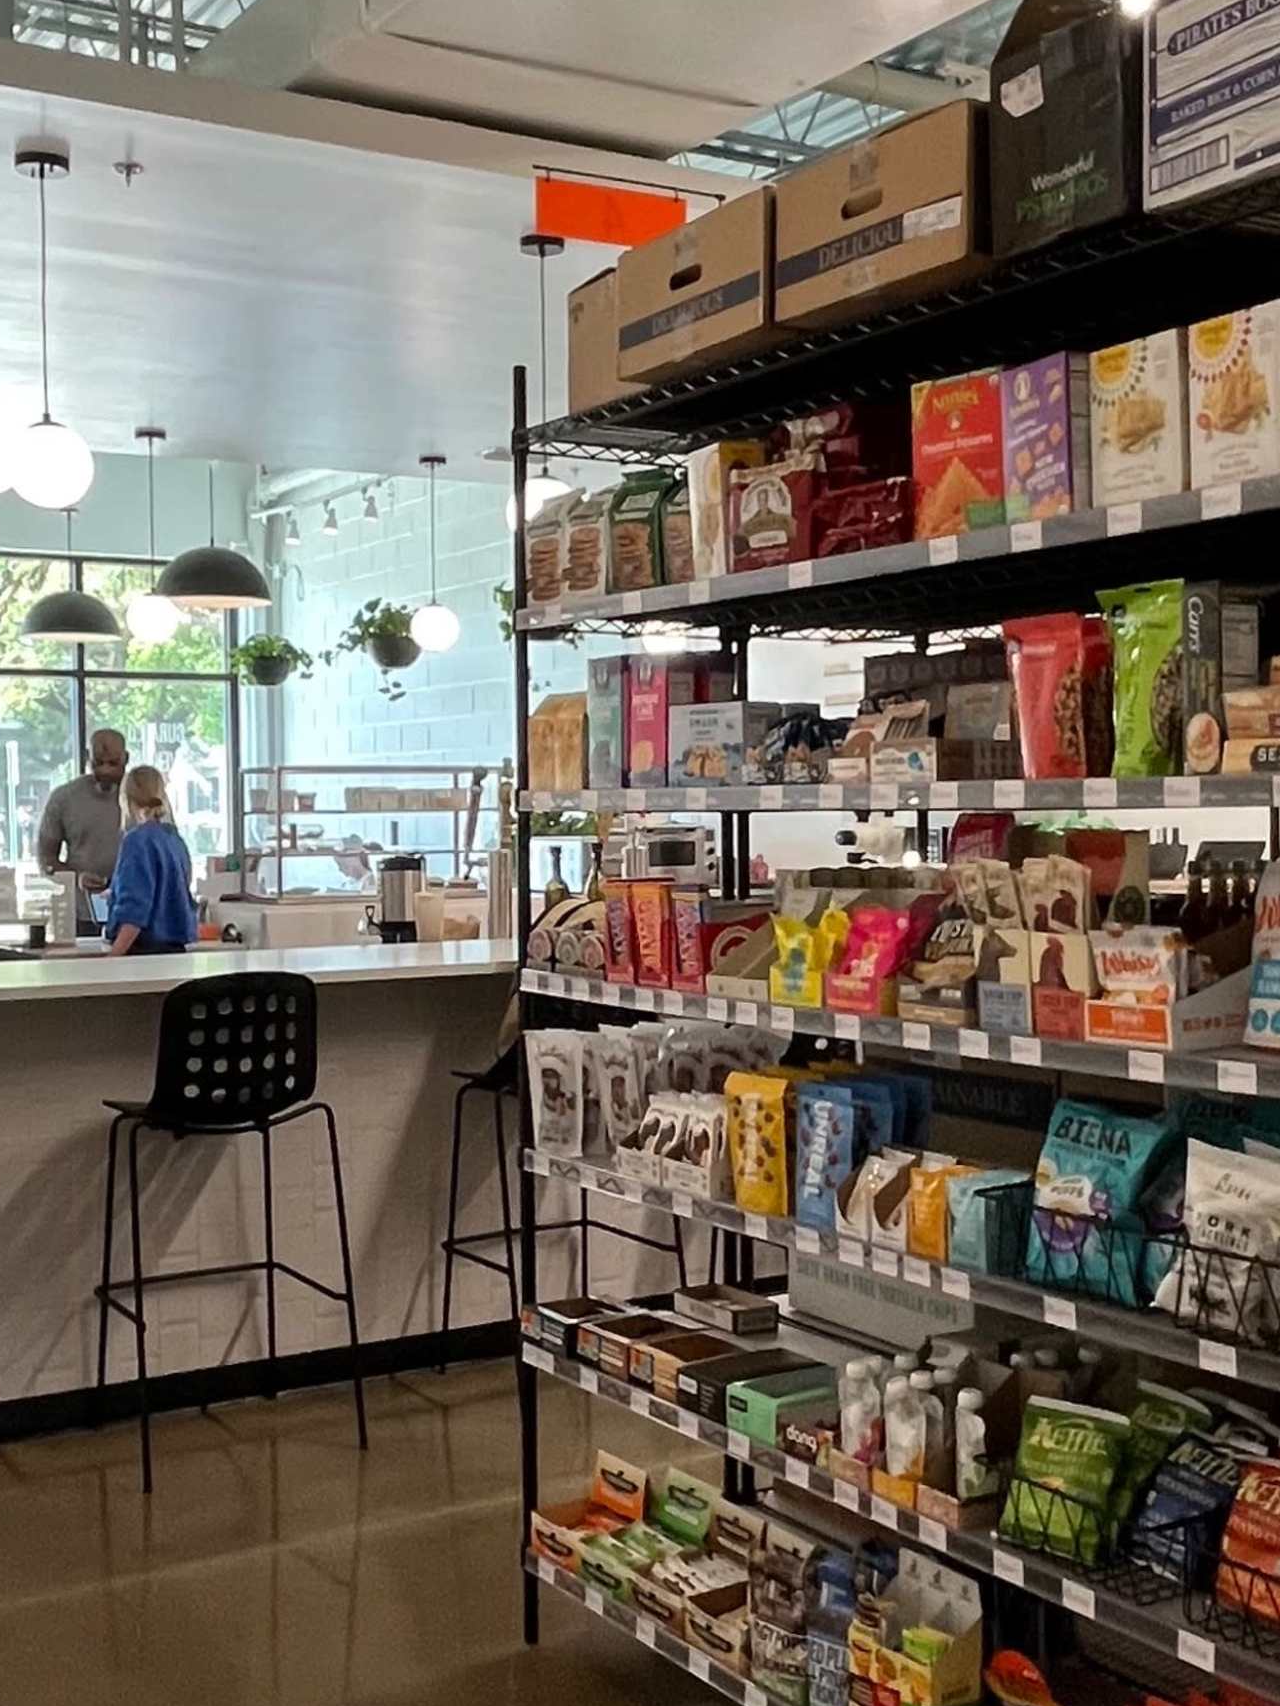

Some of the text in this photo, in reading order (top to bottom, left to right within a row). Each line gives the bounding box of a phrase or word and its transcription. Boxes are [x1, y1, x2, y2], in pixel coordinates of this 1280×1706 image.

[1031, 150, 1095, 192] Wonderful
[820, 217, 903, 270] DELICIOU
[803, 1100, 833, 1199] UNREAL
[1054, 1116, 1132, 1159] BIENA
